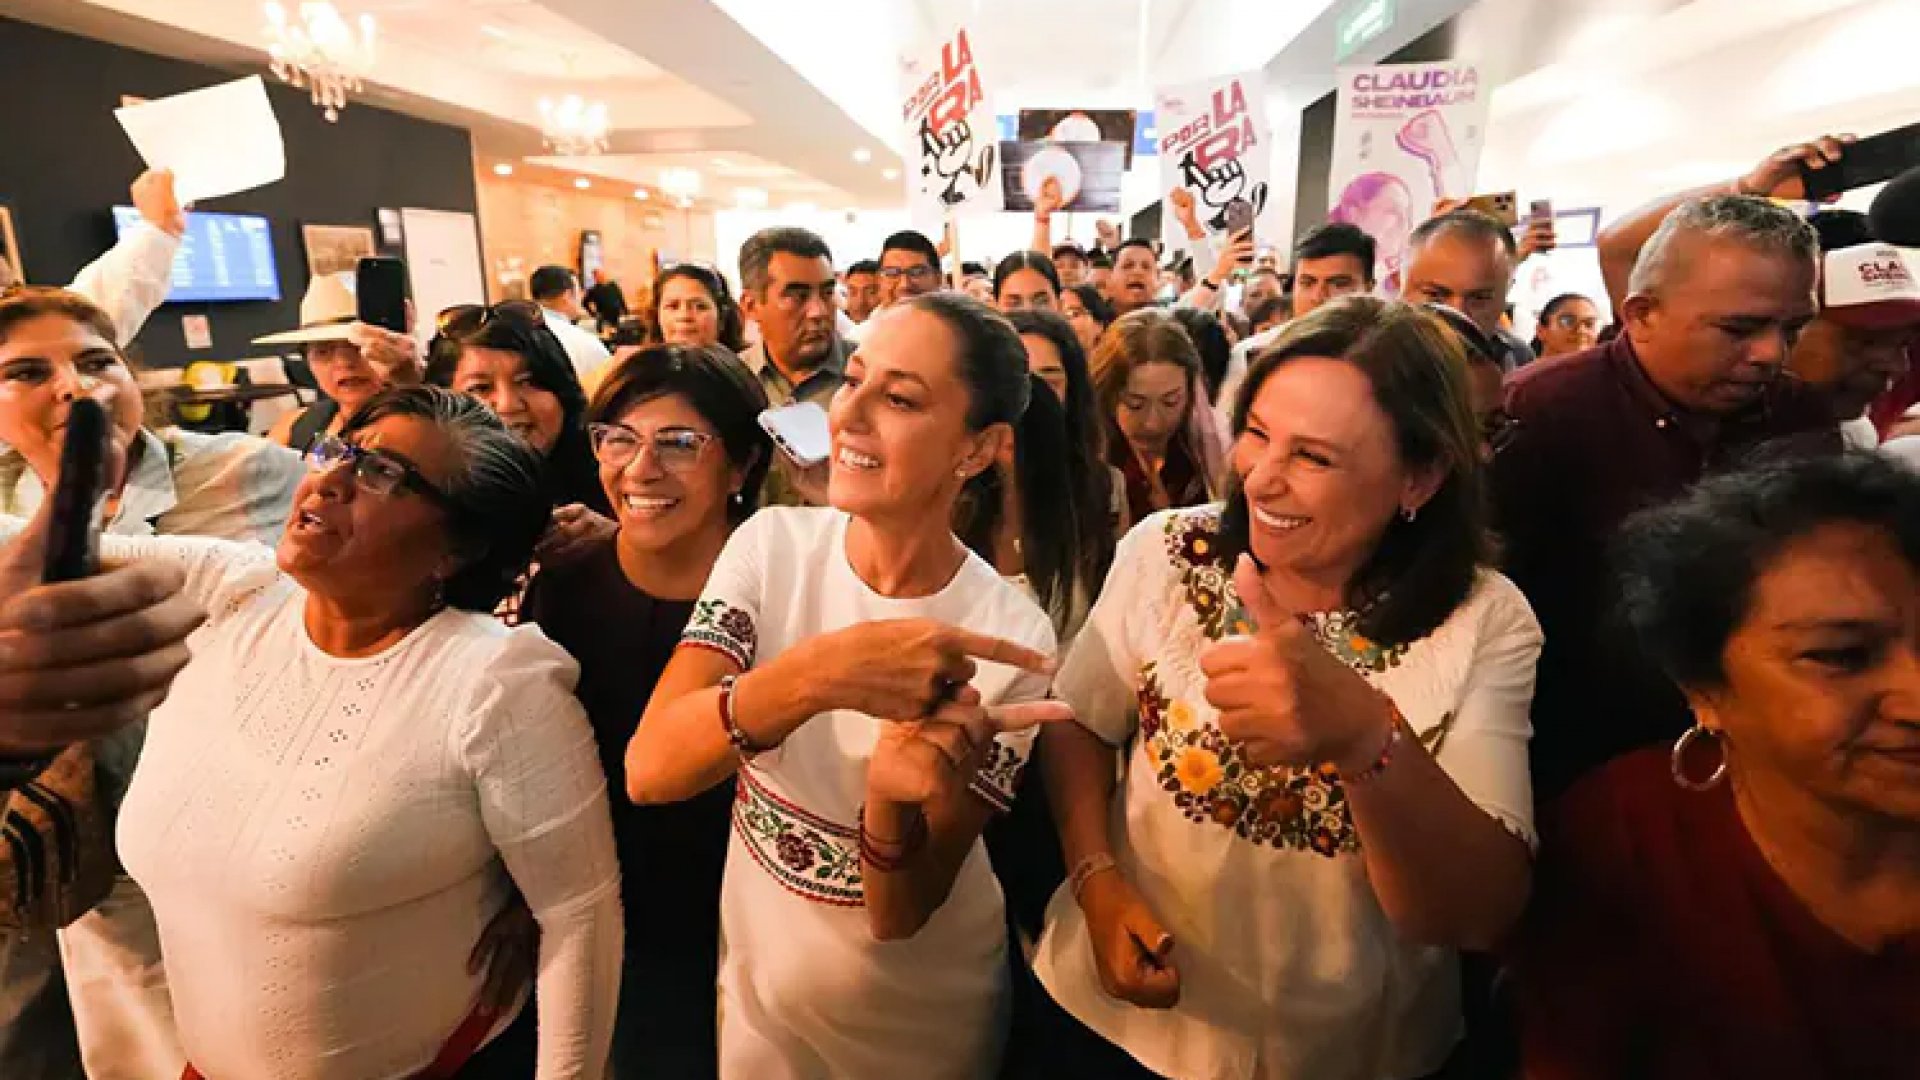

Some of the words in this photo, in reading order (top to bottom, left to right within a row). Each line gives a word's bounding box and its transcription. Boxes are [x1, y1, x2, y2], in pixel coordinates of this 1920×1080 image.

[942, 28, 973, 86] LA
[1353, 67, 1477, 92] CLAUDIA
[1212, 79, 1246, 129] LA
